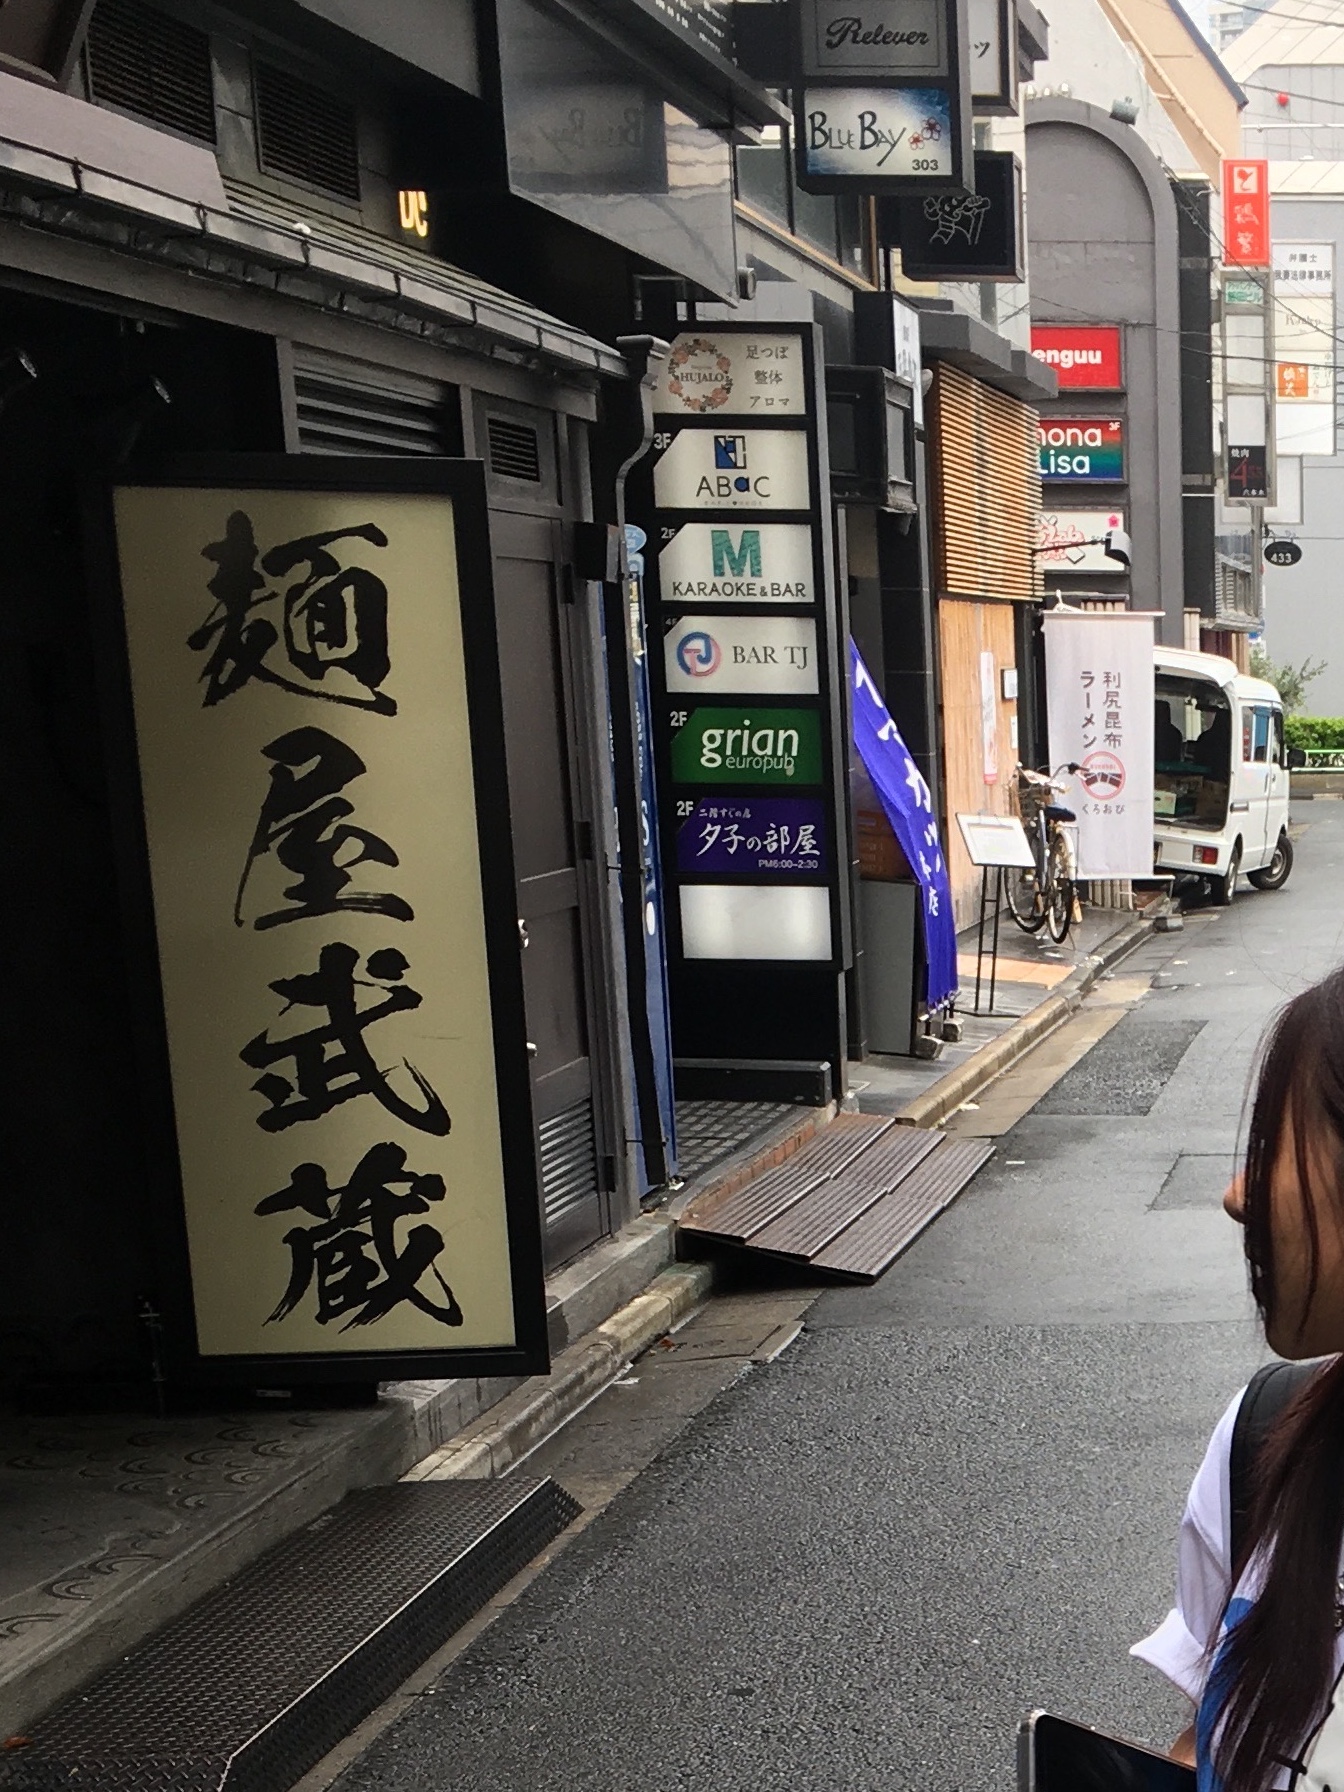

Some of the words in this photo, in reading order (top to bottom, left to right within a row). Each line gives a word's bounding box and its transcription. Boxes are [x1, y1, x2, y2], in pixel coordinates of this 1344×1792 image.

[825, 17, 929, 49] Relever
[912, 159, 939, 171] 303
[745, 345, 789, 359] 足つぼ
[754, 369, 783, 387] 整体
[750, 395, 790, 408] アロマ
[654, 433, 671, 450] 3F
[661, 528, 676, 539] 2F
[711, 529, 762, 578] M
[672, 582, 756, 597] KARAOKE
[771, 582, 807, 598] BAR
[732, 646, 779, 664] BAR
[784, 646, 809, 670] TJ
[670, 711, 688, 727] 2F
[1080, 671, 1098, 749] ラーメン
[1103, 671, 1123, 749] 利尻昆布
[700, 719, 799, 768] grian
[725, 752, 795, 774] europub
[676, 801, 694, 816] 2F
[1082, 803, 1125, 816] くろおび
[696, 823, 821, 857] 夕子の部屋
[187, 510, 464, 1337] 麺屋武蔵
